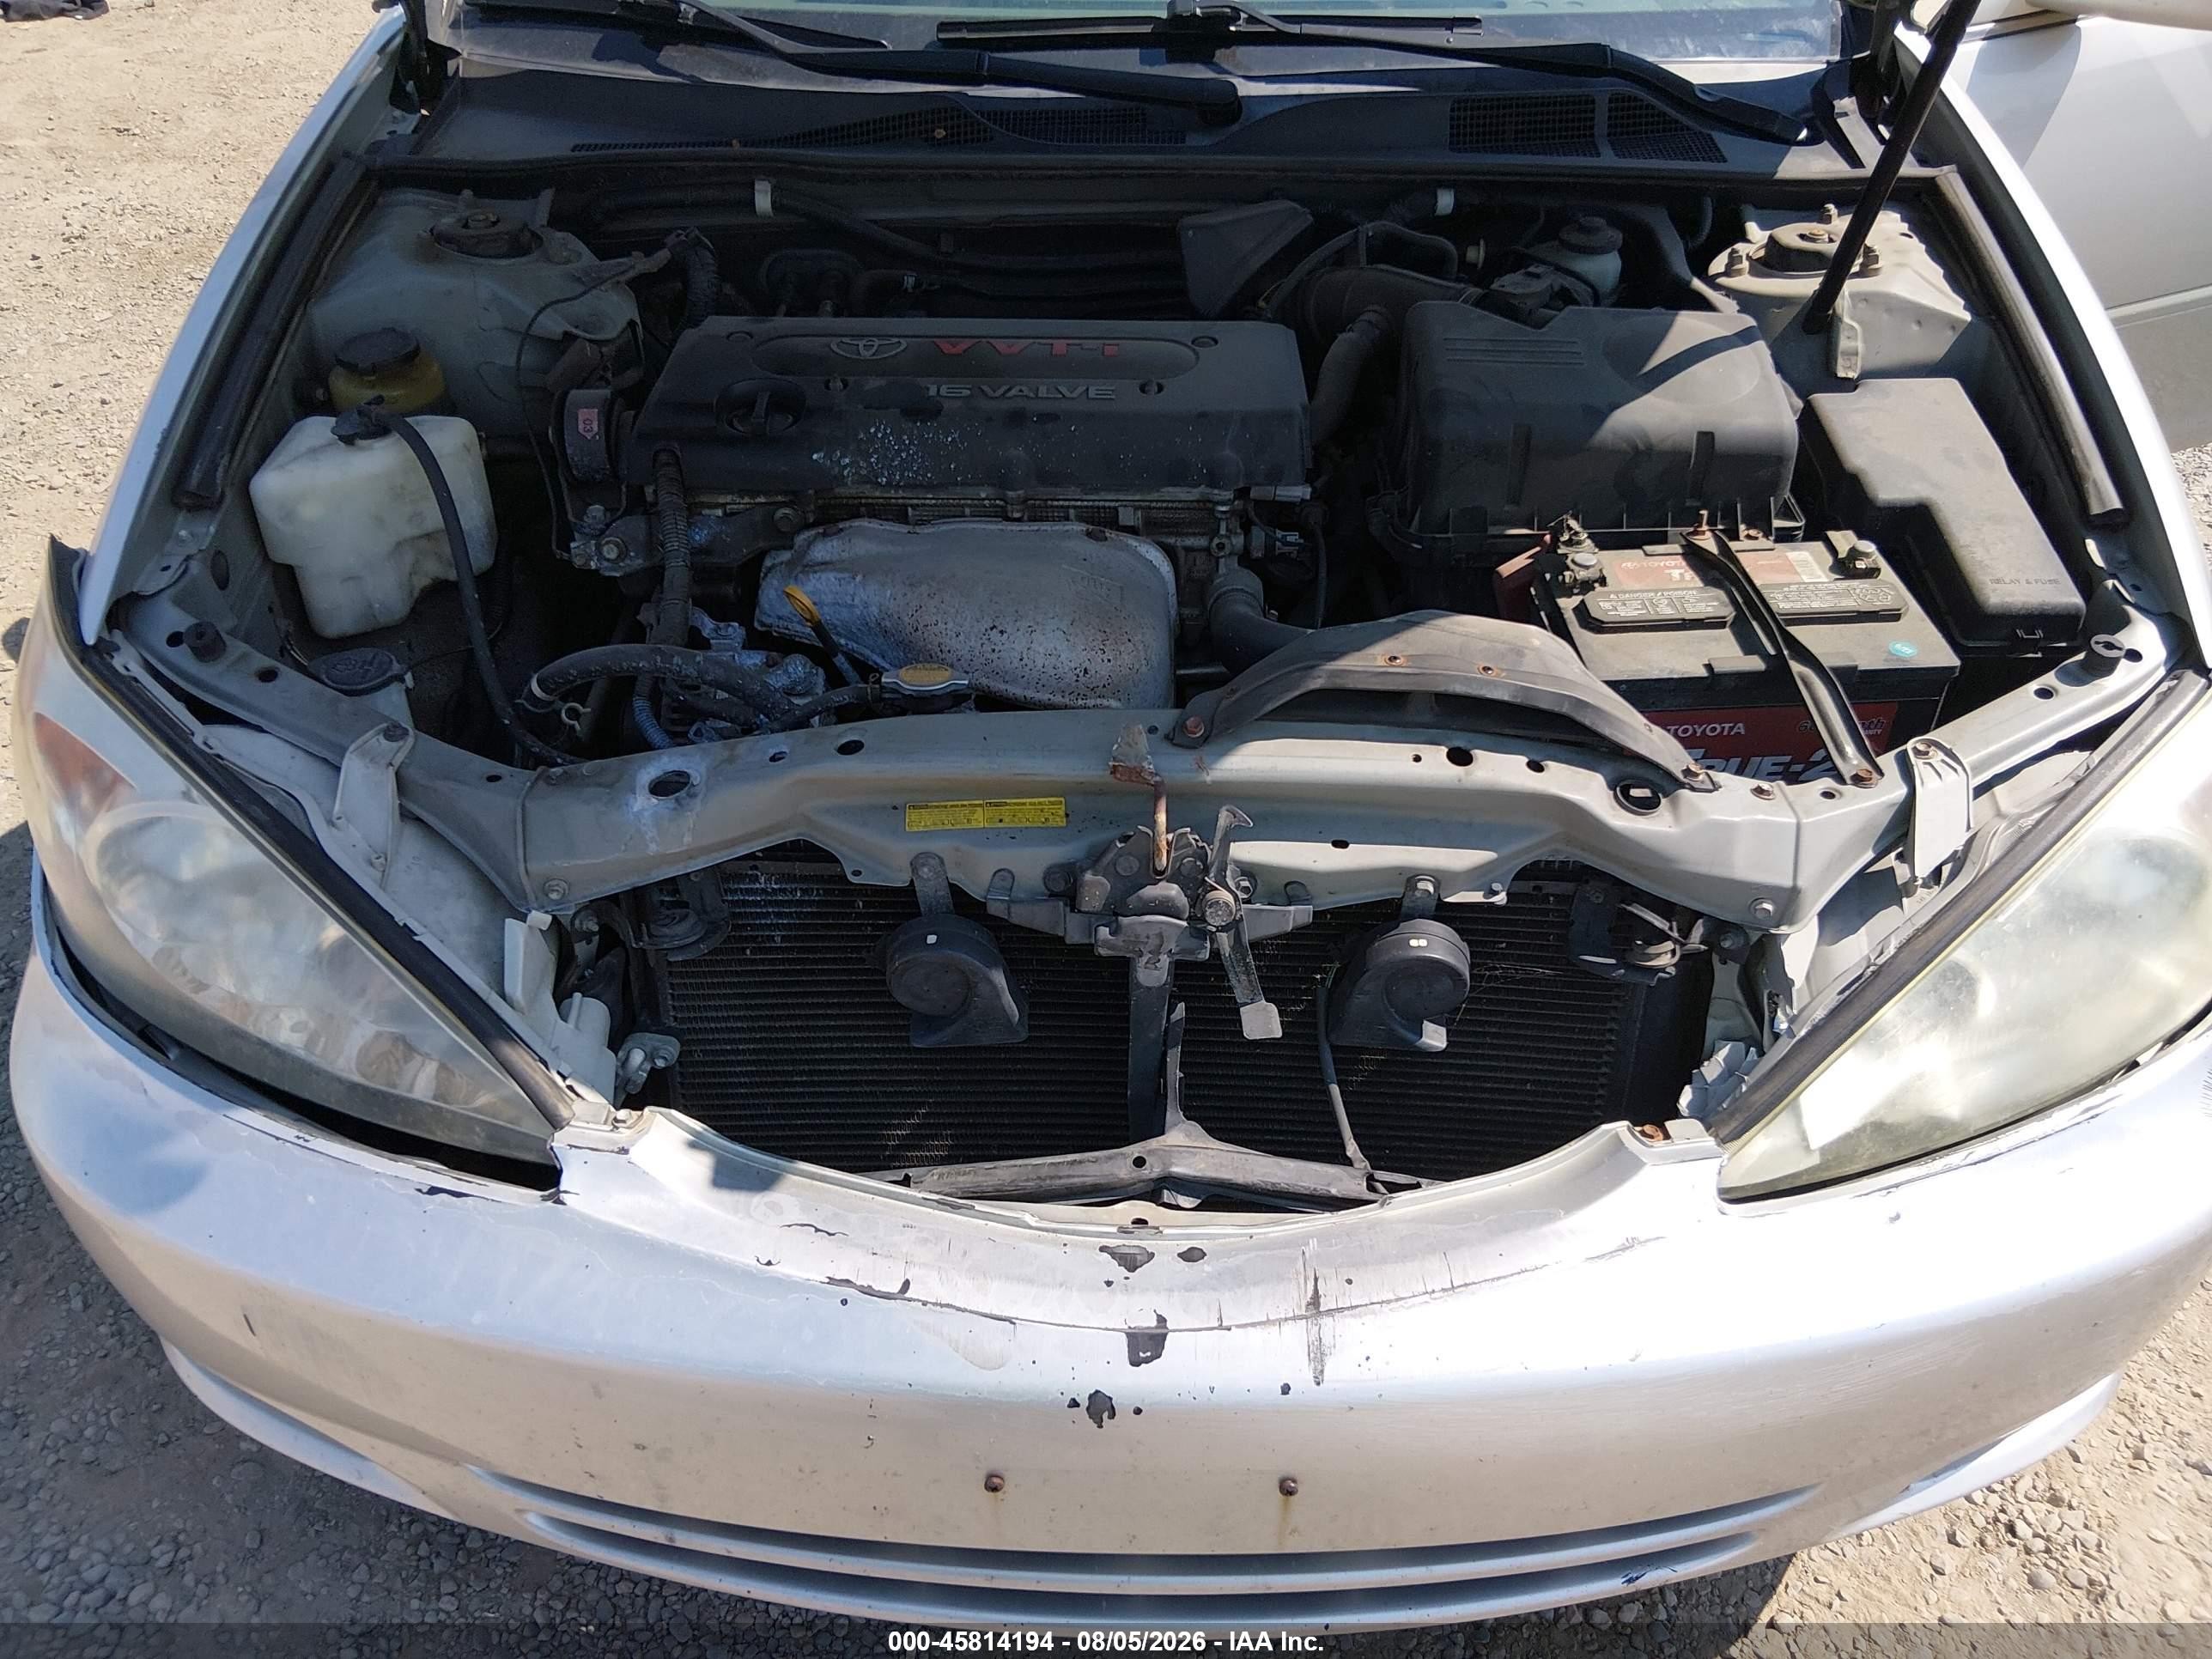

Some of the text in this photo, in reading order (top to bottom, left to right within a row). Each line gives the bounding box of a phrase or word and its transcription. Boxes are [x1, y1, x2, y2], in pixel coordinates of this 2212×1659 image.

[926, 385, 1116, 399] 16 VALVE
[1668, 723, 1746, 738] TOYOTA
